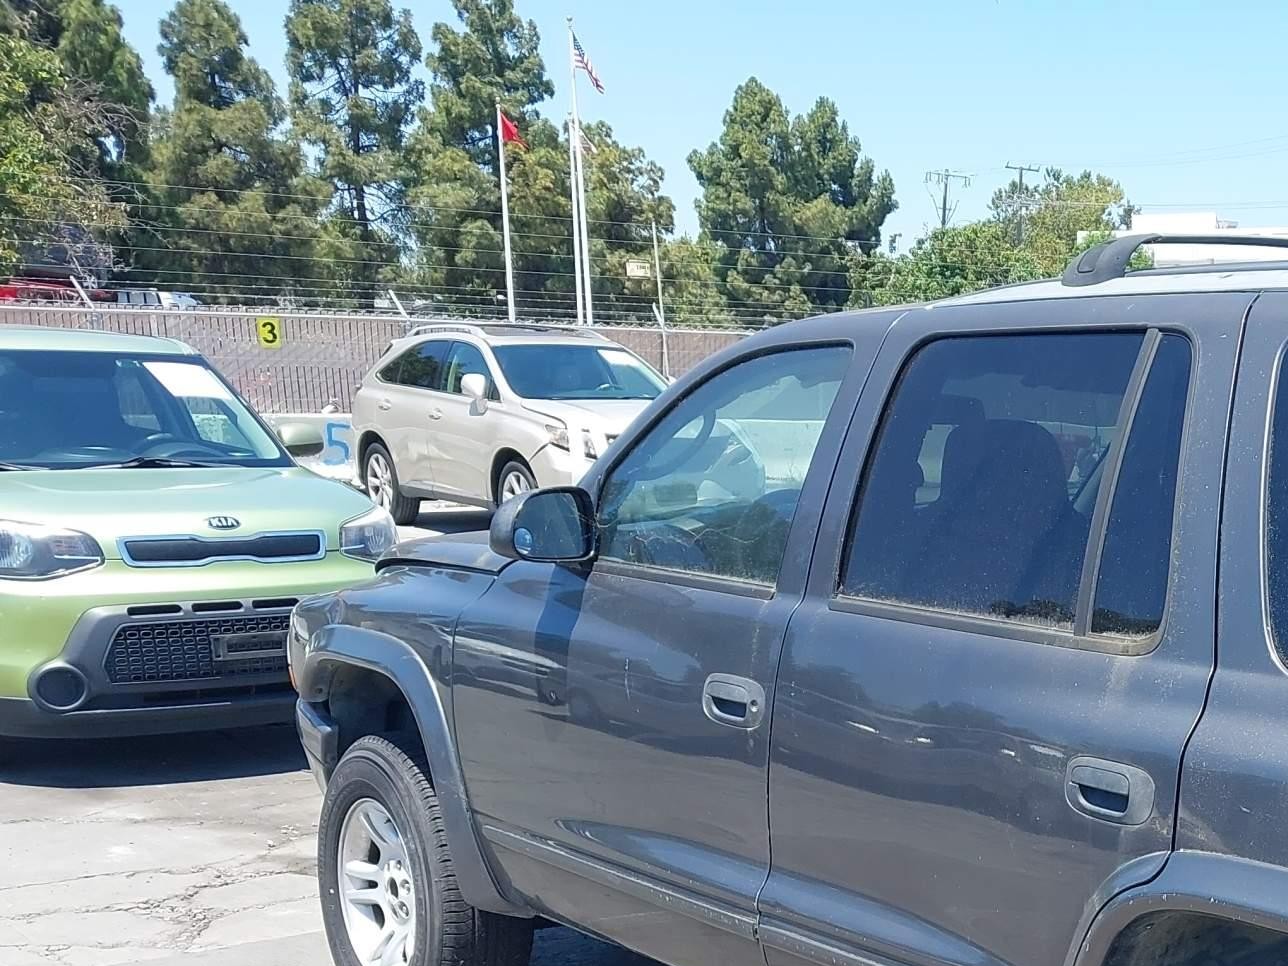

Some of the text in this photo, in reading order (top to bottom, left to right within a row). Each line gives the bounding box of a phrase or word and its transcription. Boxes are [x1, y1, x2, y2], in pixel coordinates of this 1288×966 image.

[261, 321, 278, 344] 3
[322, 421, 352, 465] 5
[210, 516, 238, 527] KIA
